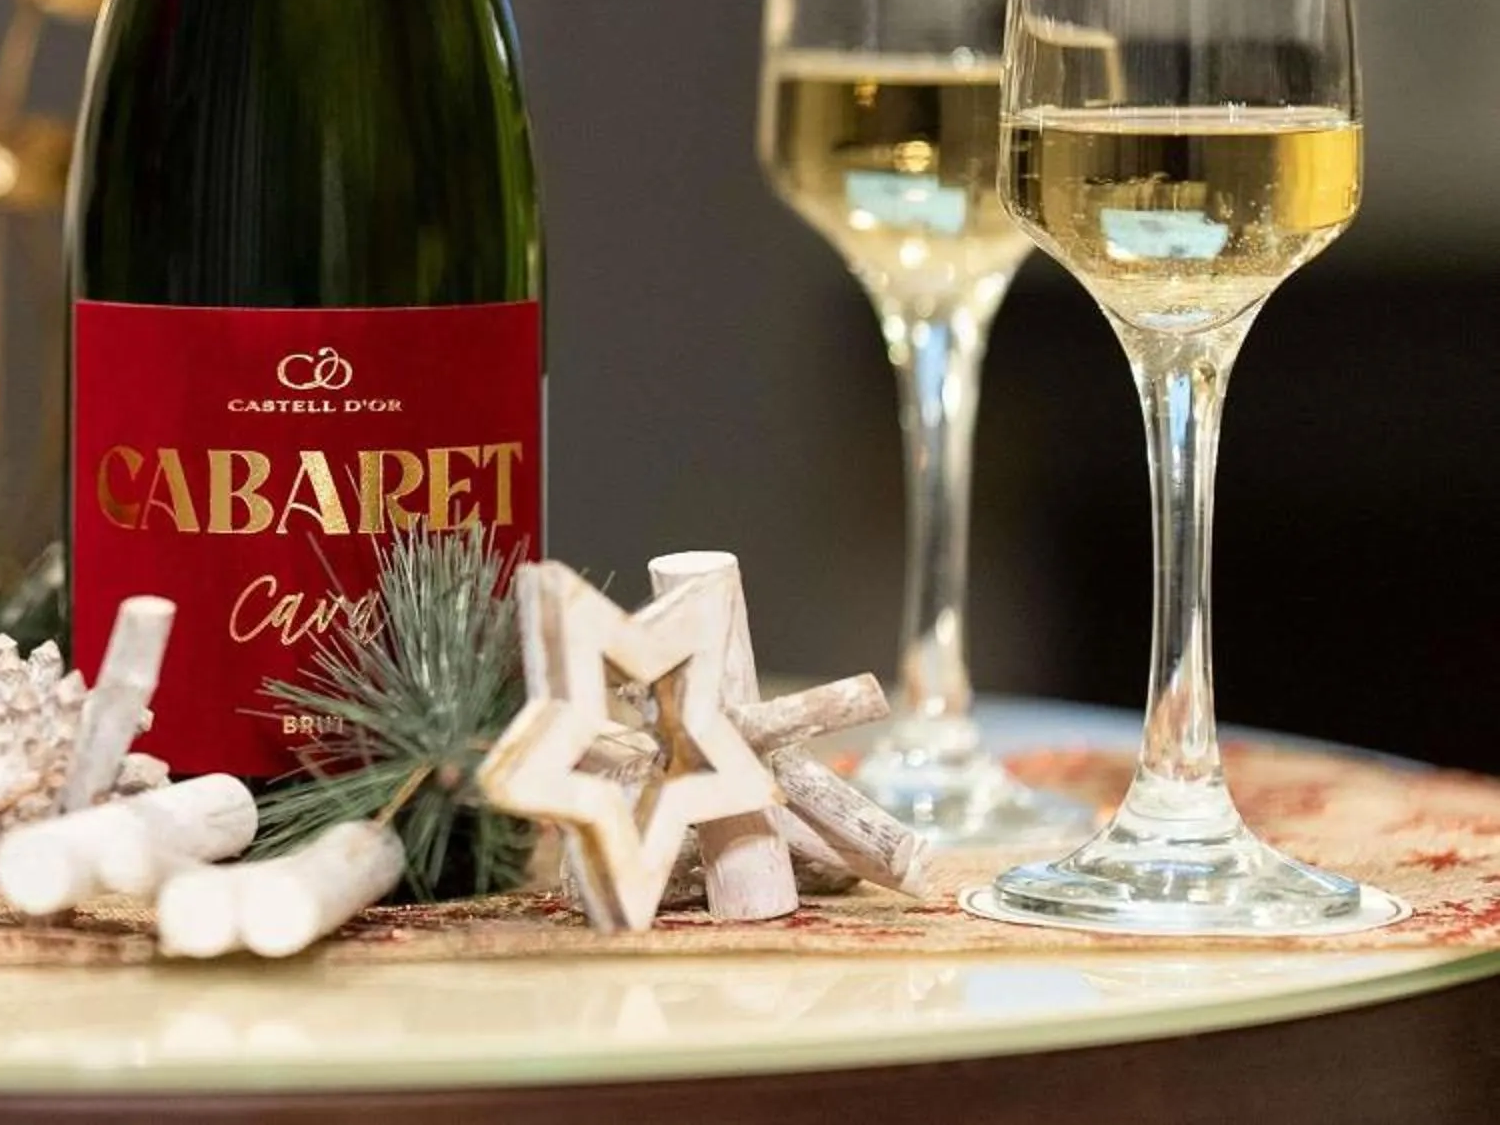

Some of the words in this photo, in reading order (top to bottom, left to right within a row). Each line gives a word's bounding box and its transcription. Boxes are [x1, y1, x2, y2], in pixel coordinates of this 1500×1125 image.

[227, 398, 337, 413] CASTELL
[343, 398, 403, 413] D'OR
[97, 442, 523, 535] CABARET
